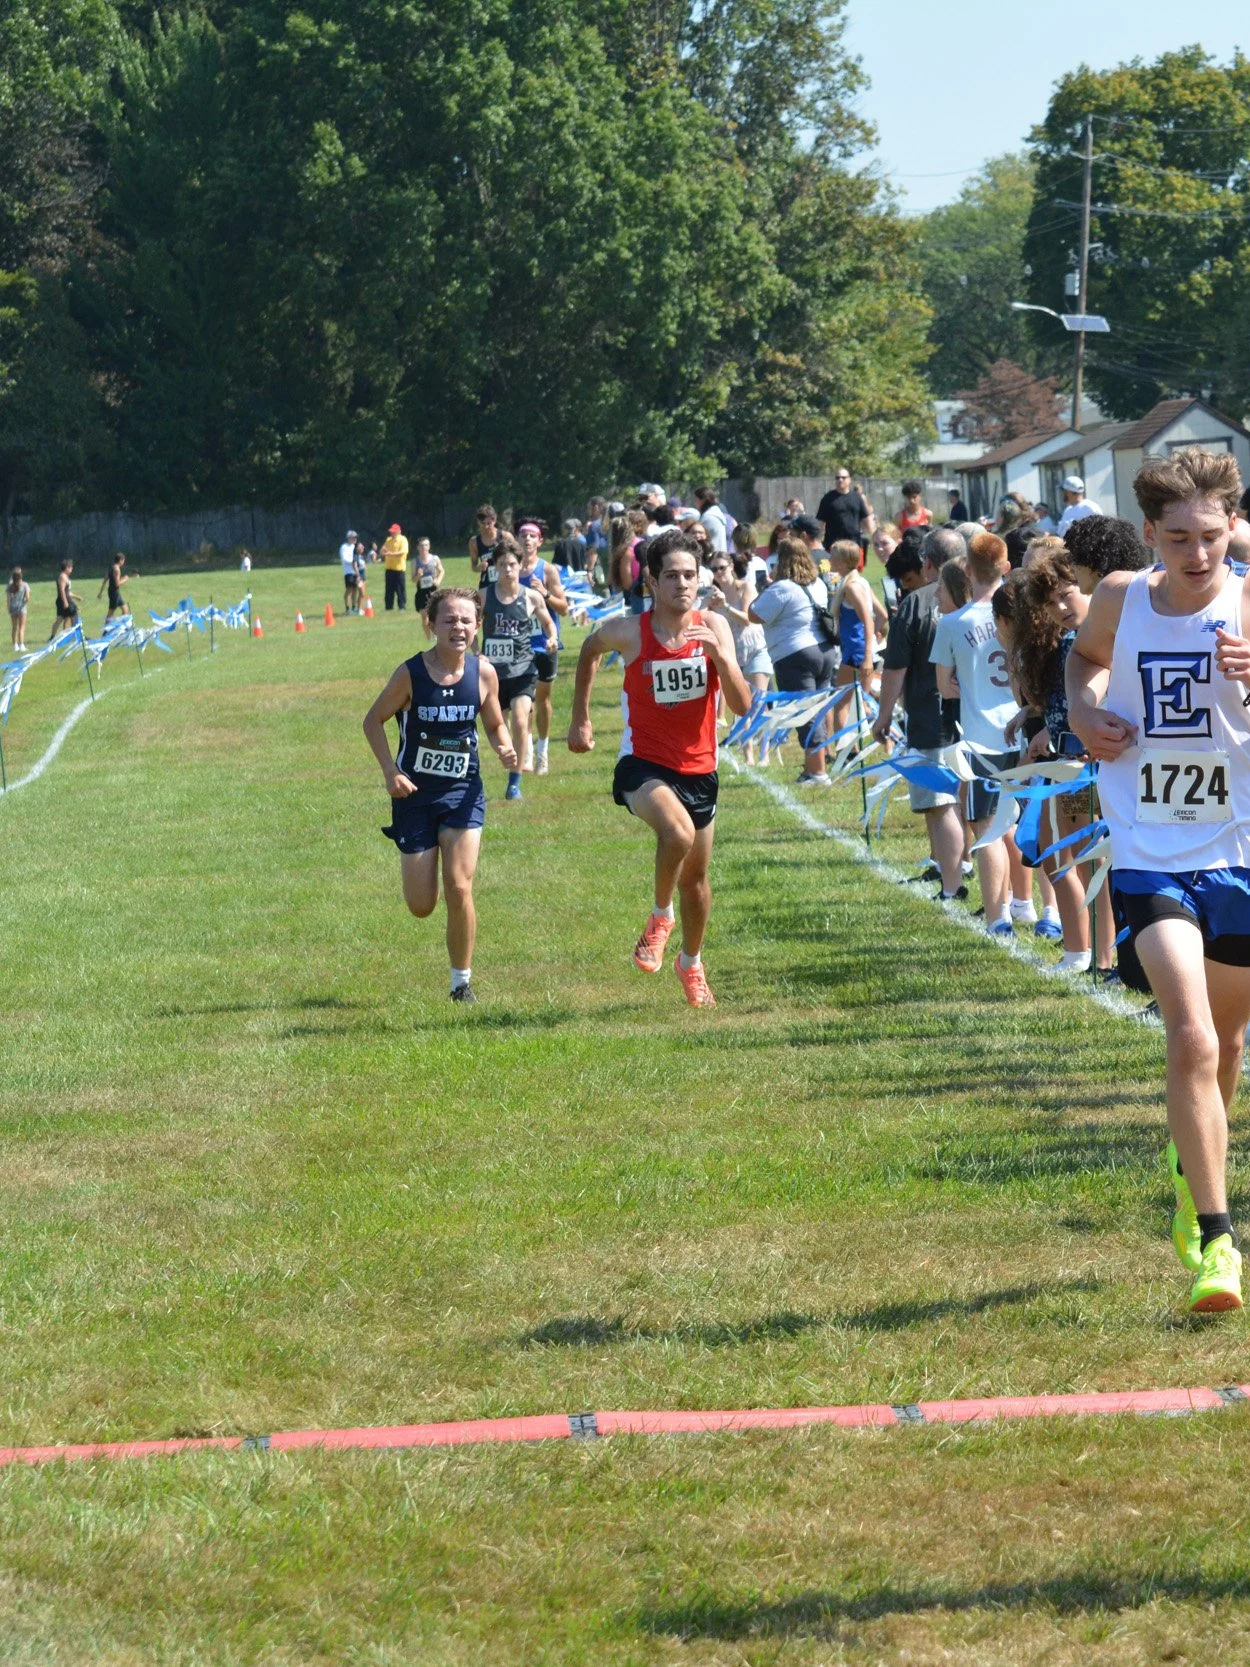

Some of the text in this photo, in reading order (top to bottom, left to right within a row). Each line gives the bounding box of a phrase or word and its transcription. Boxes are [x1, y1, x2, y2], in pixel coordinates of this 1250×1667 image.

[495, 613, 519, 635] LM
[485, 643, 513, 657] 1833
[655, 666, 706, 692] 1951
[418, 705, 475, 721] SPARTA
[421, 752, 466, 774] 6293
[1141, 763, 1229, 805] 1724
